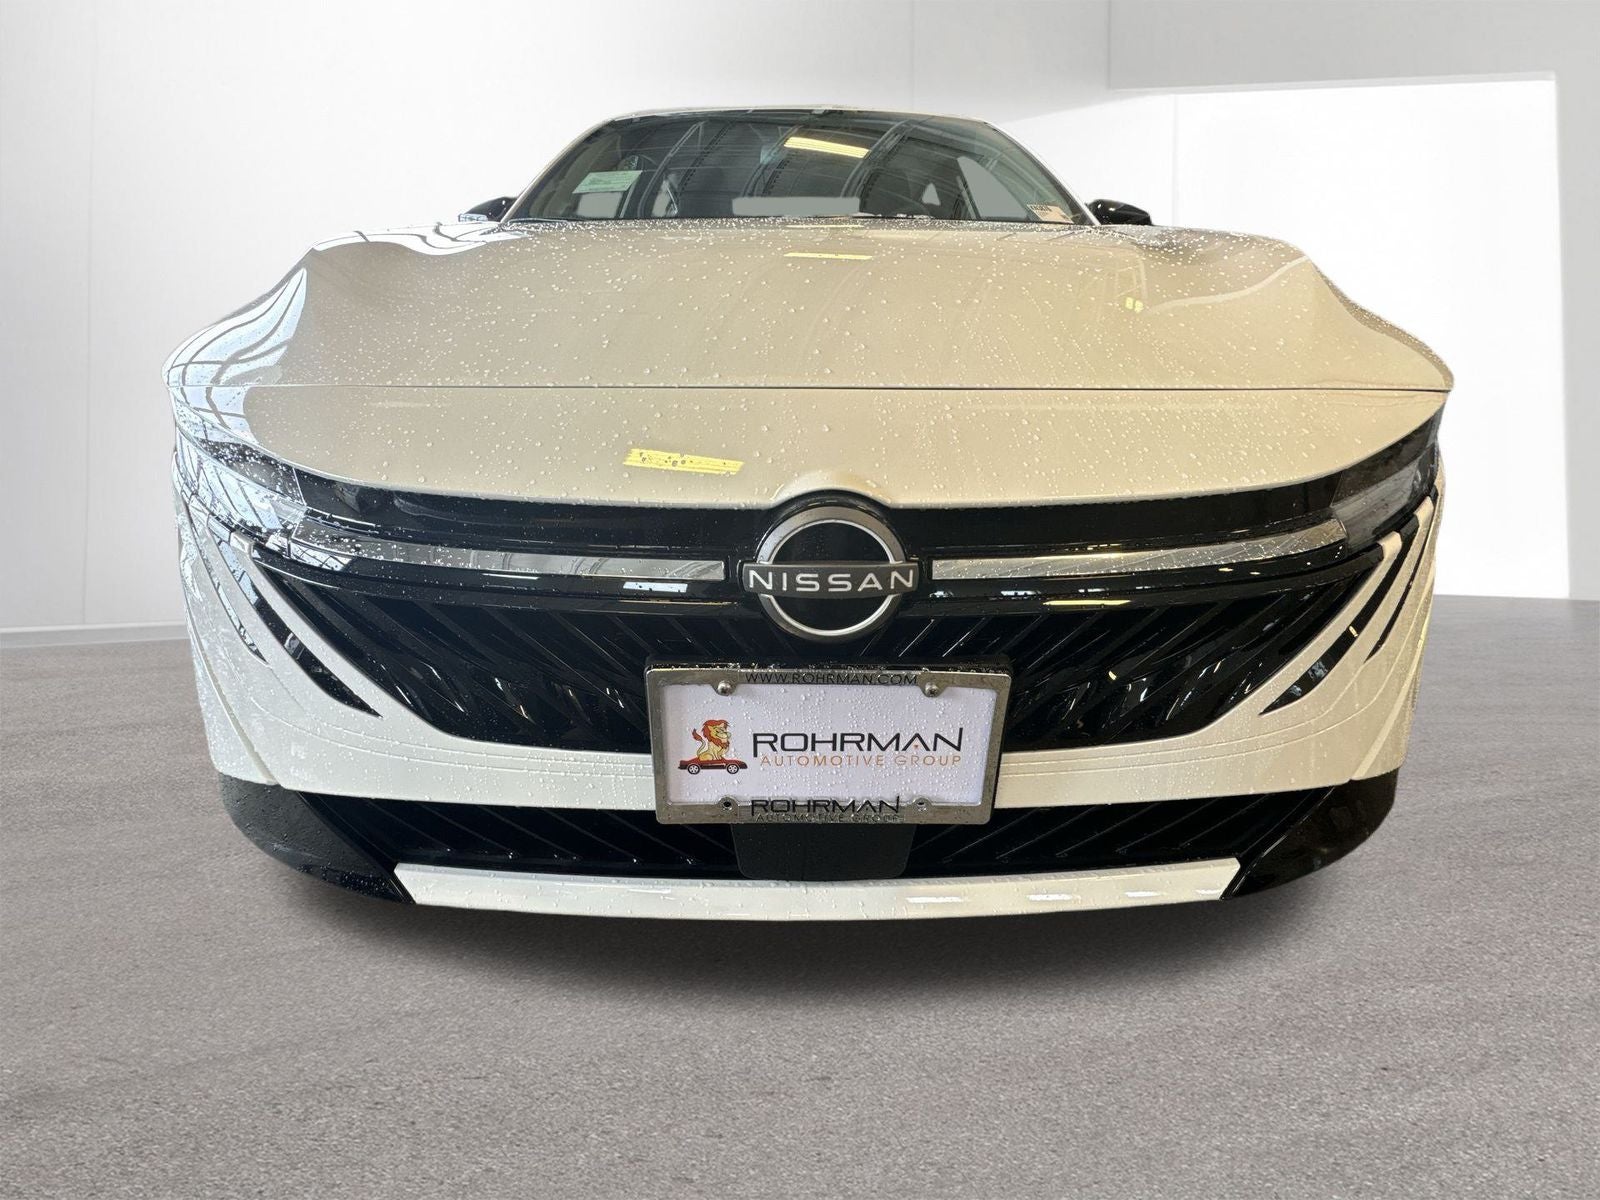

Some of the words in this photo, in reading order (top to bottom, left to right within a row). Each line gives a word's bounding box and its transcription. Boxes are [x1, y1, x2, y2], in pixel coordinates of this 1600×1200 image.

[748, 569, 914, 592] NISSAN
[745, 672, 918, 685] WWW.ROHRMAN.COM
[752, 727, 963, 758] ROHRMAN
[760, 754, 885, 767] AUTOMOTIVE
[894, 754, 962, 767] GROUP
[751, 795, 900, 817] ROHRMAN
[755, 814, 844, 823] AUTOMOTIVE
